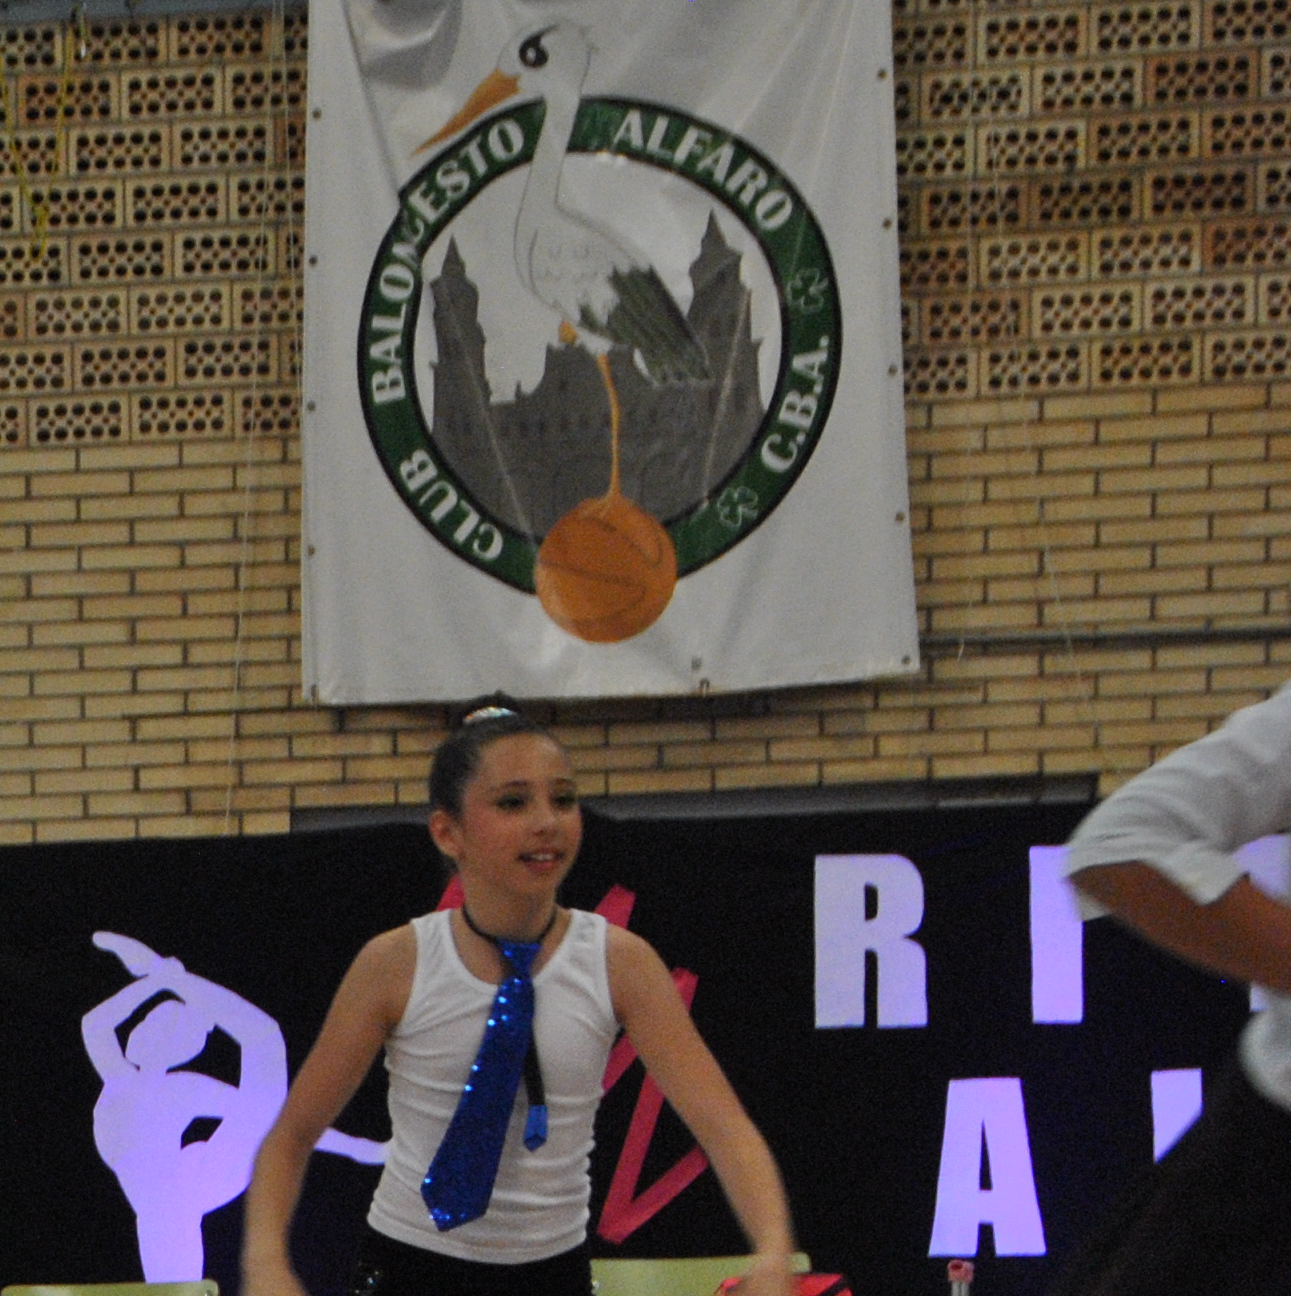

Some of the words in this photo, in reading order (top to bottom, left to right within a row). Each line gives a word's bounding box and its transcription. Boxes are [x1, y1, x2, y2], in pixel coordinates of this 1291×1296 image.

[399, 449, 504, 562] CLUB
[612, 108, 793, 231] ALFARO
[761, 335, 830, 473] C.B.A.
